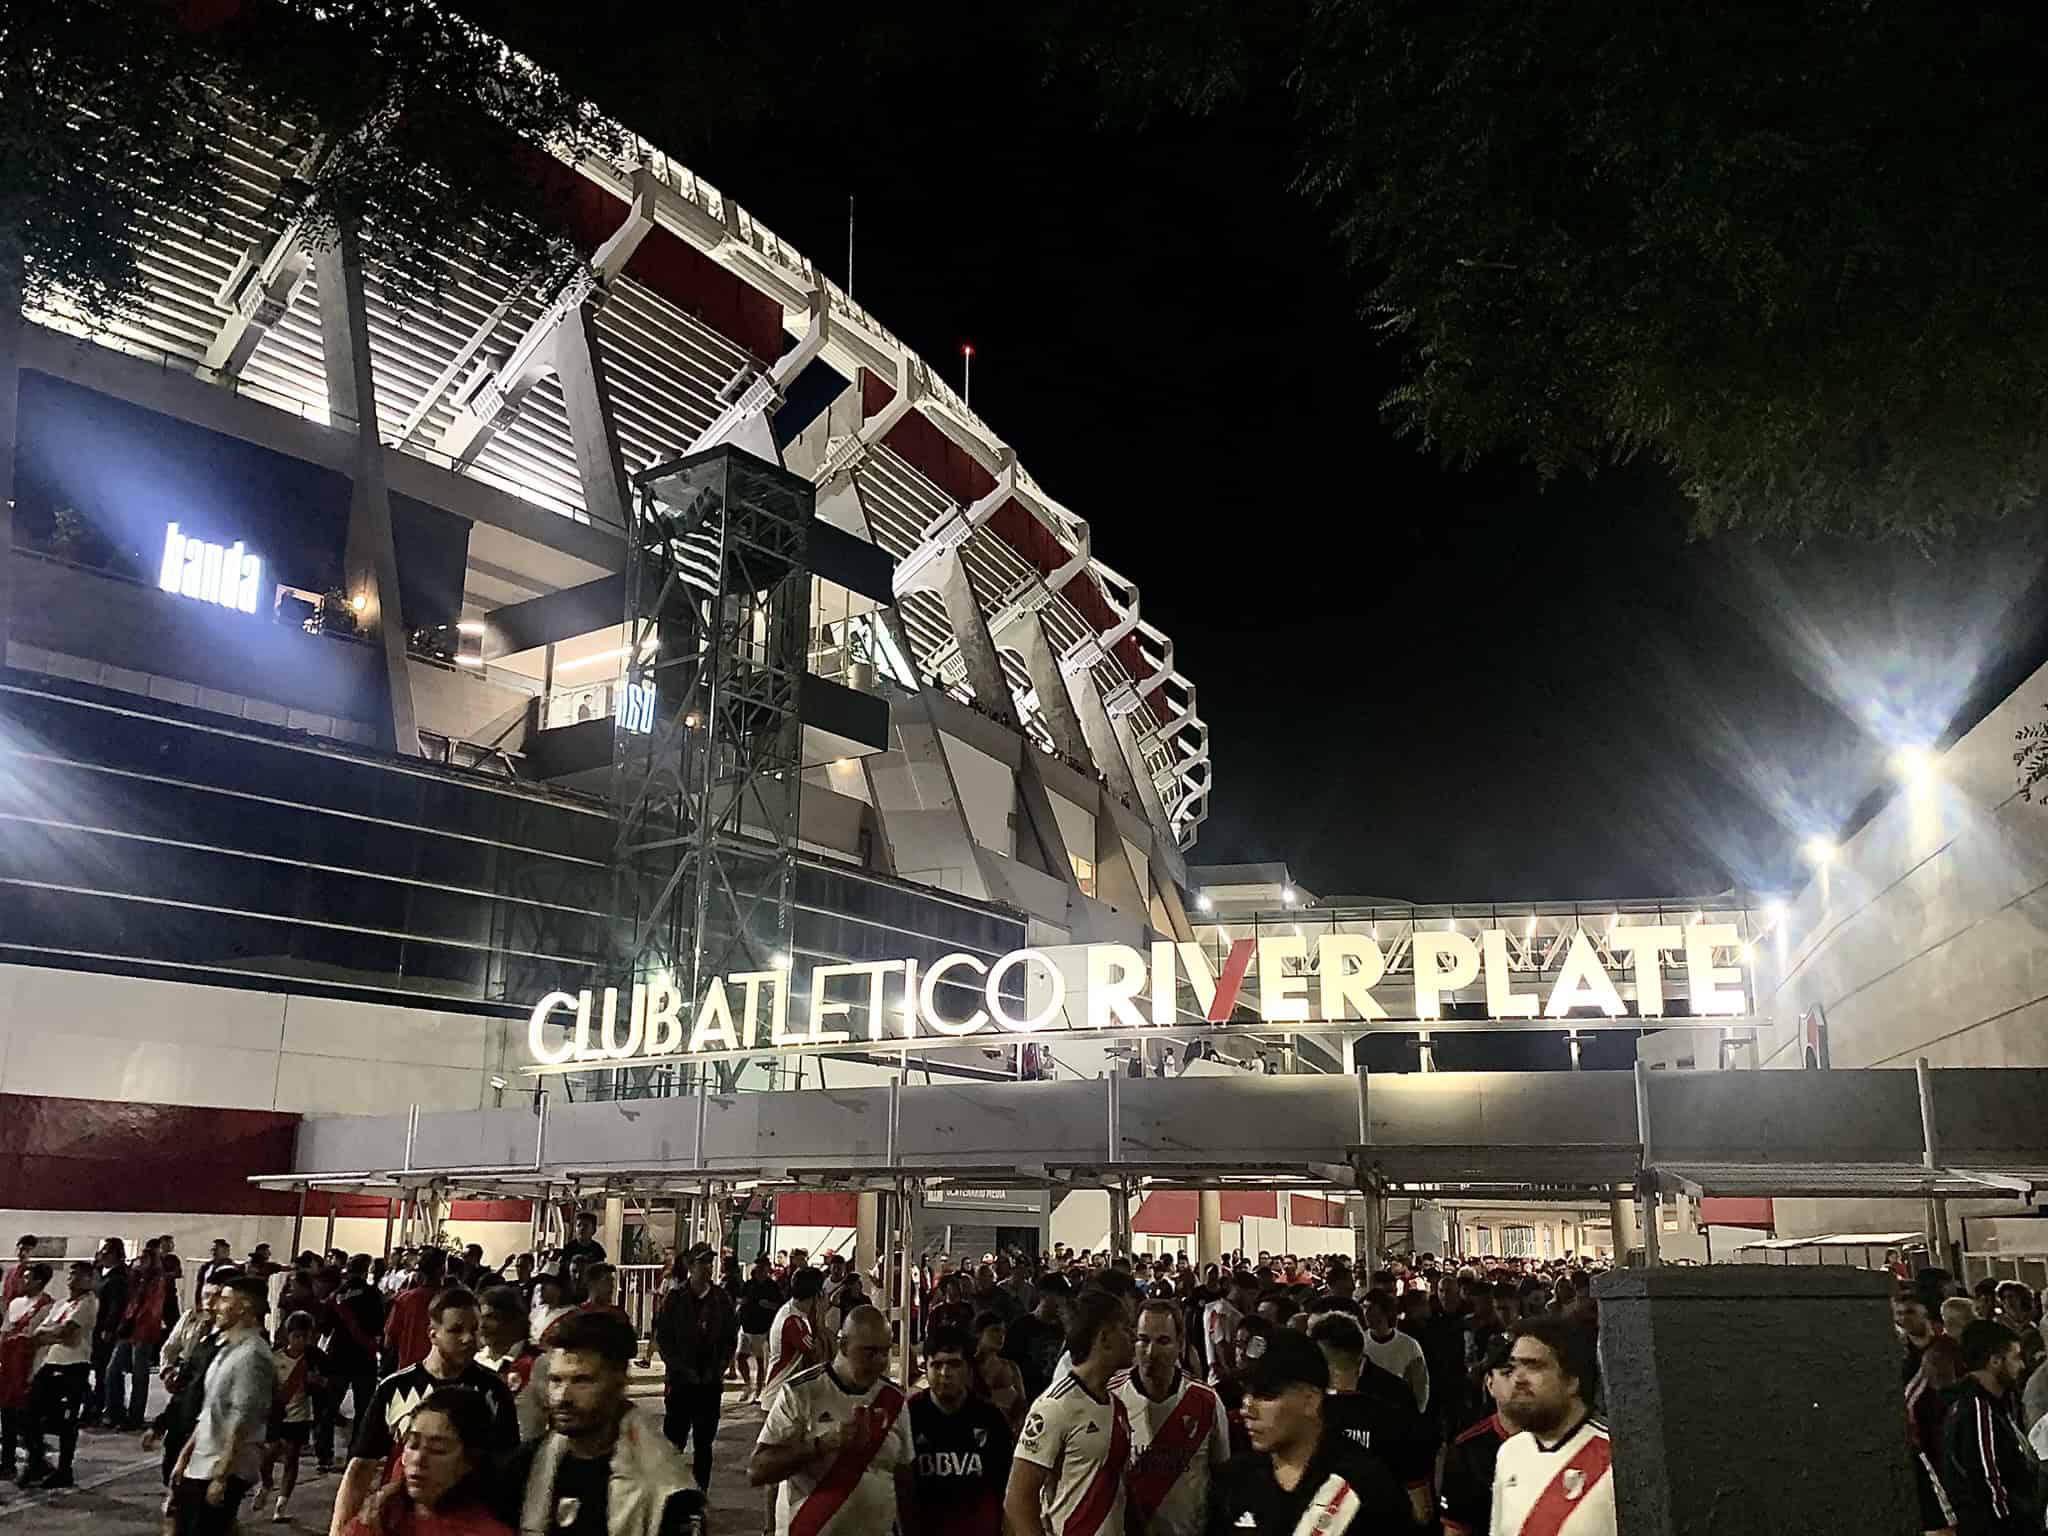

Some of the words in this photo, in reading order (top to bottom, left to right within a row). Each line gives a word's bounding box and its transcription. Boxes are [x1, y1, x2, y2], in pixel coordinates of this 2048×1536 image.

[160, 521, 260, 615] banda
[527, 983, 682, 1065] CLUB
[691, 948, 1066, 1052] ATLETICO
[1086, 934, 1389, 1027] RIVER
[1413, 923, 1748, 1020] PLATE
[918, 1451, 983, 1477] BBVA
